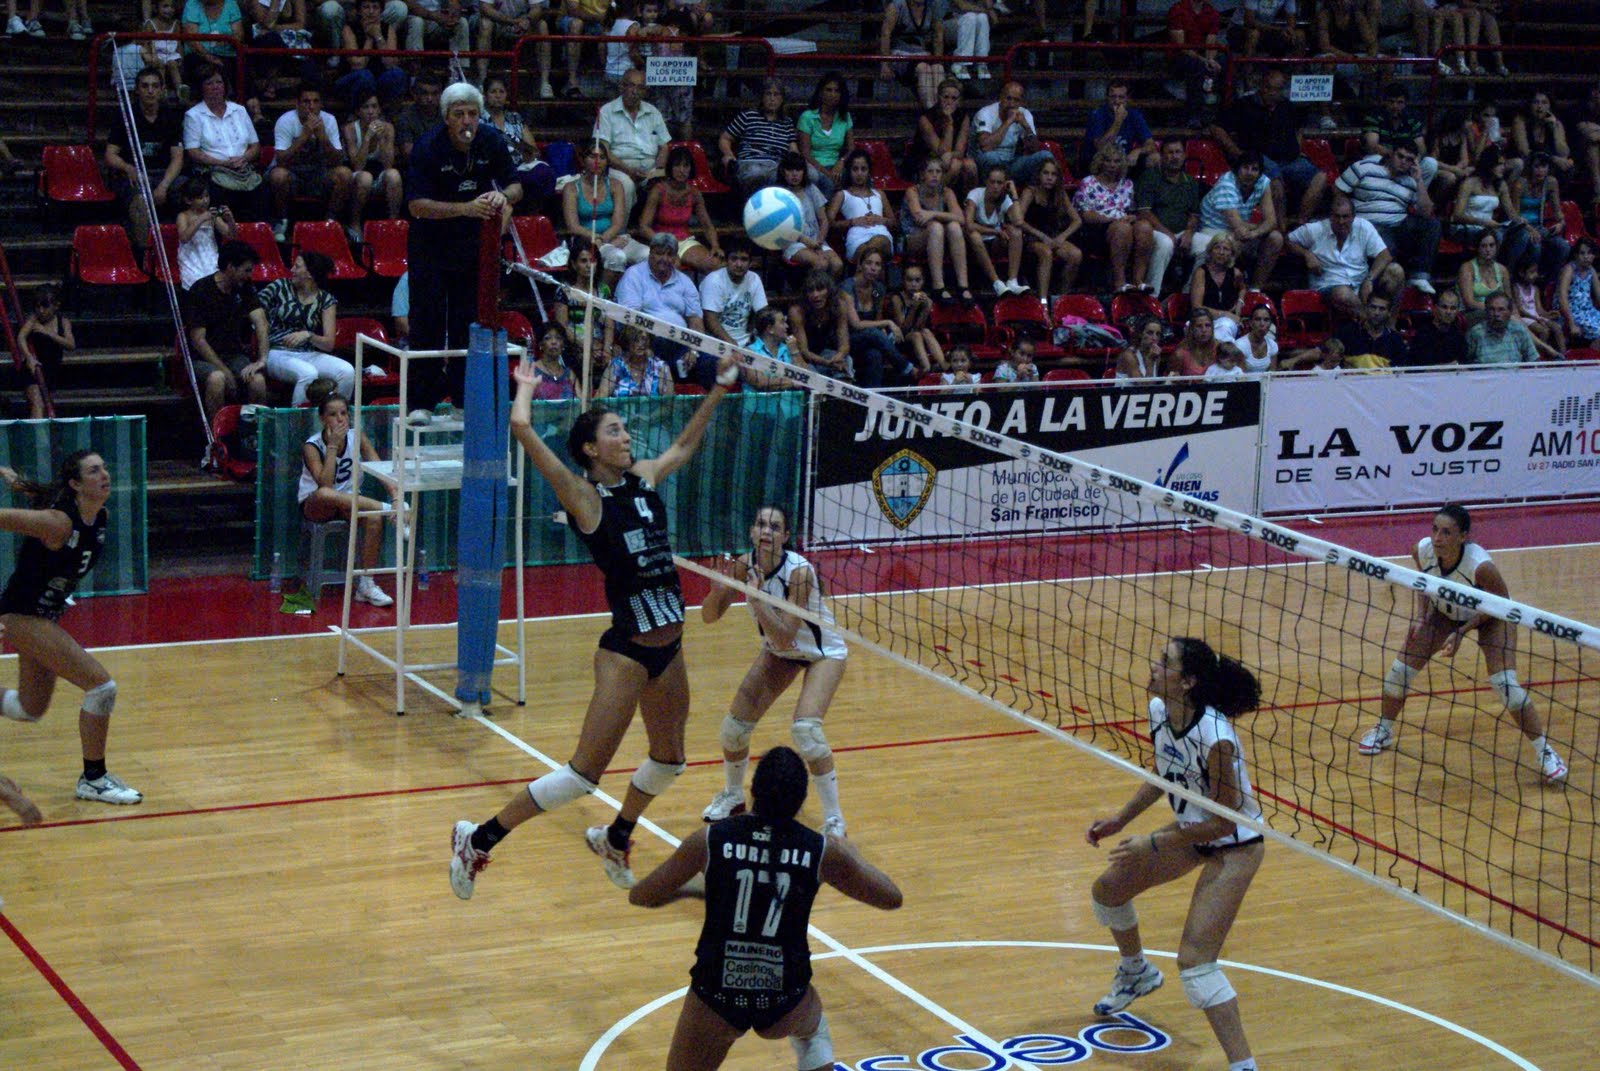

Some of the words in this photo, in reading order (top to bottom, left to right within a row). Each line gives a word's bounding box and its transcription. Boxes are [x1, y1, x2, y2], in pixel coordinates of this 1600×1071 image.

[663, 60, 694, 68] APOYAR
[853, 400, 992, 442] JUNTO
[1000, 399, 1027, 435] A
[1040, 395, 1086, 432] LA
[1101, 391, 1228, 430] VERDE
[1277, 427, 1361, 460] LA
[1388, 420, 1505, 455] VOZ
[1275, 468, 1313, 483] DE
[1335, 464, 1392, 480] SAN
[1411, 458, 1501, 478] JUSTO
[1527, 462, 1537, 470] LV
[1538, 462, 1550, 470] 27
[1552, 460, 1576, 469] RADIO
[1577, 459, 1594, 467] SAN
[992, 468, 1068, 485] Municipa
[1170, 480, 1202, 492] BIEN
[991, 492, 1009, 504] de
[1013, 489, 1026, 503] la
[1031, 485, 1079, 502] Ciudad
[1084, 484, 1101, 499] de
[633, 496, 654, 523] 4
[991, 507, 1020, 522] San
[1026, 504, 1100, 521] Francisco
[77, 550, 92, 573] 3
[733, 868, 791, 937] 17
[831, 1011, 1172, 1071] peps
